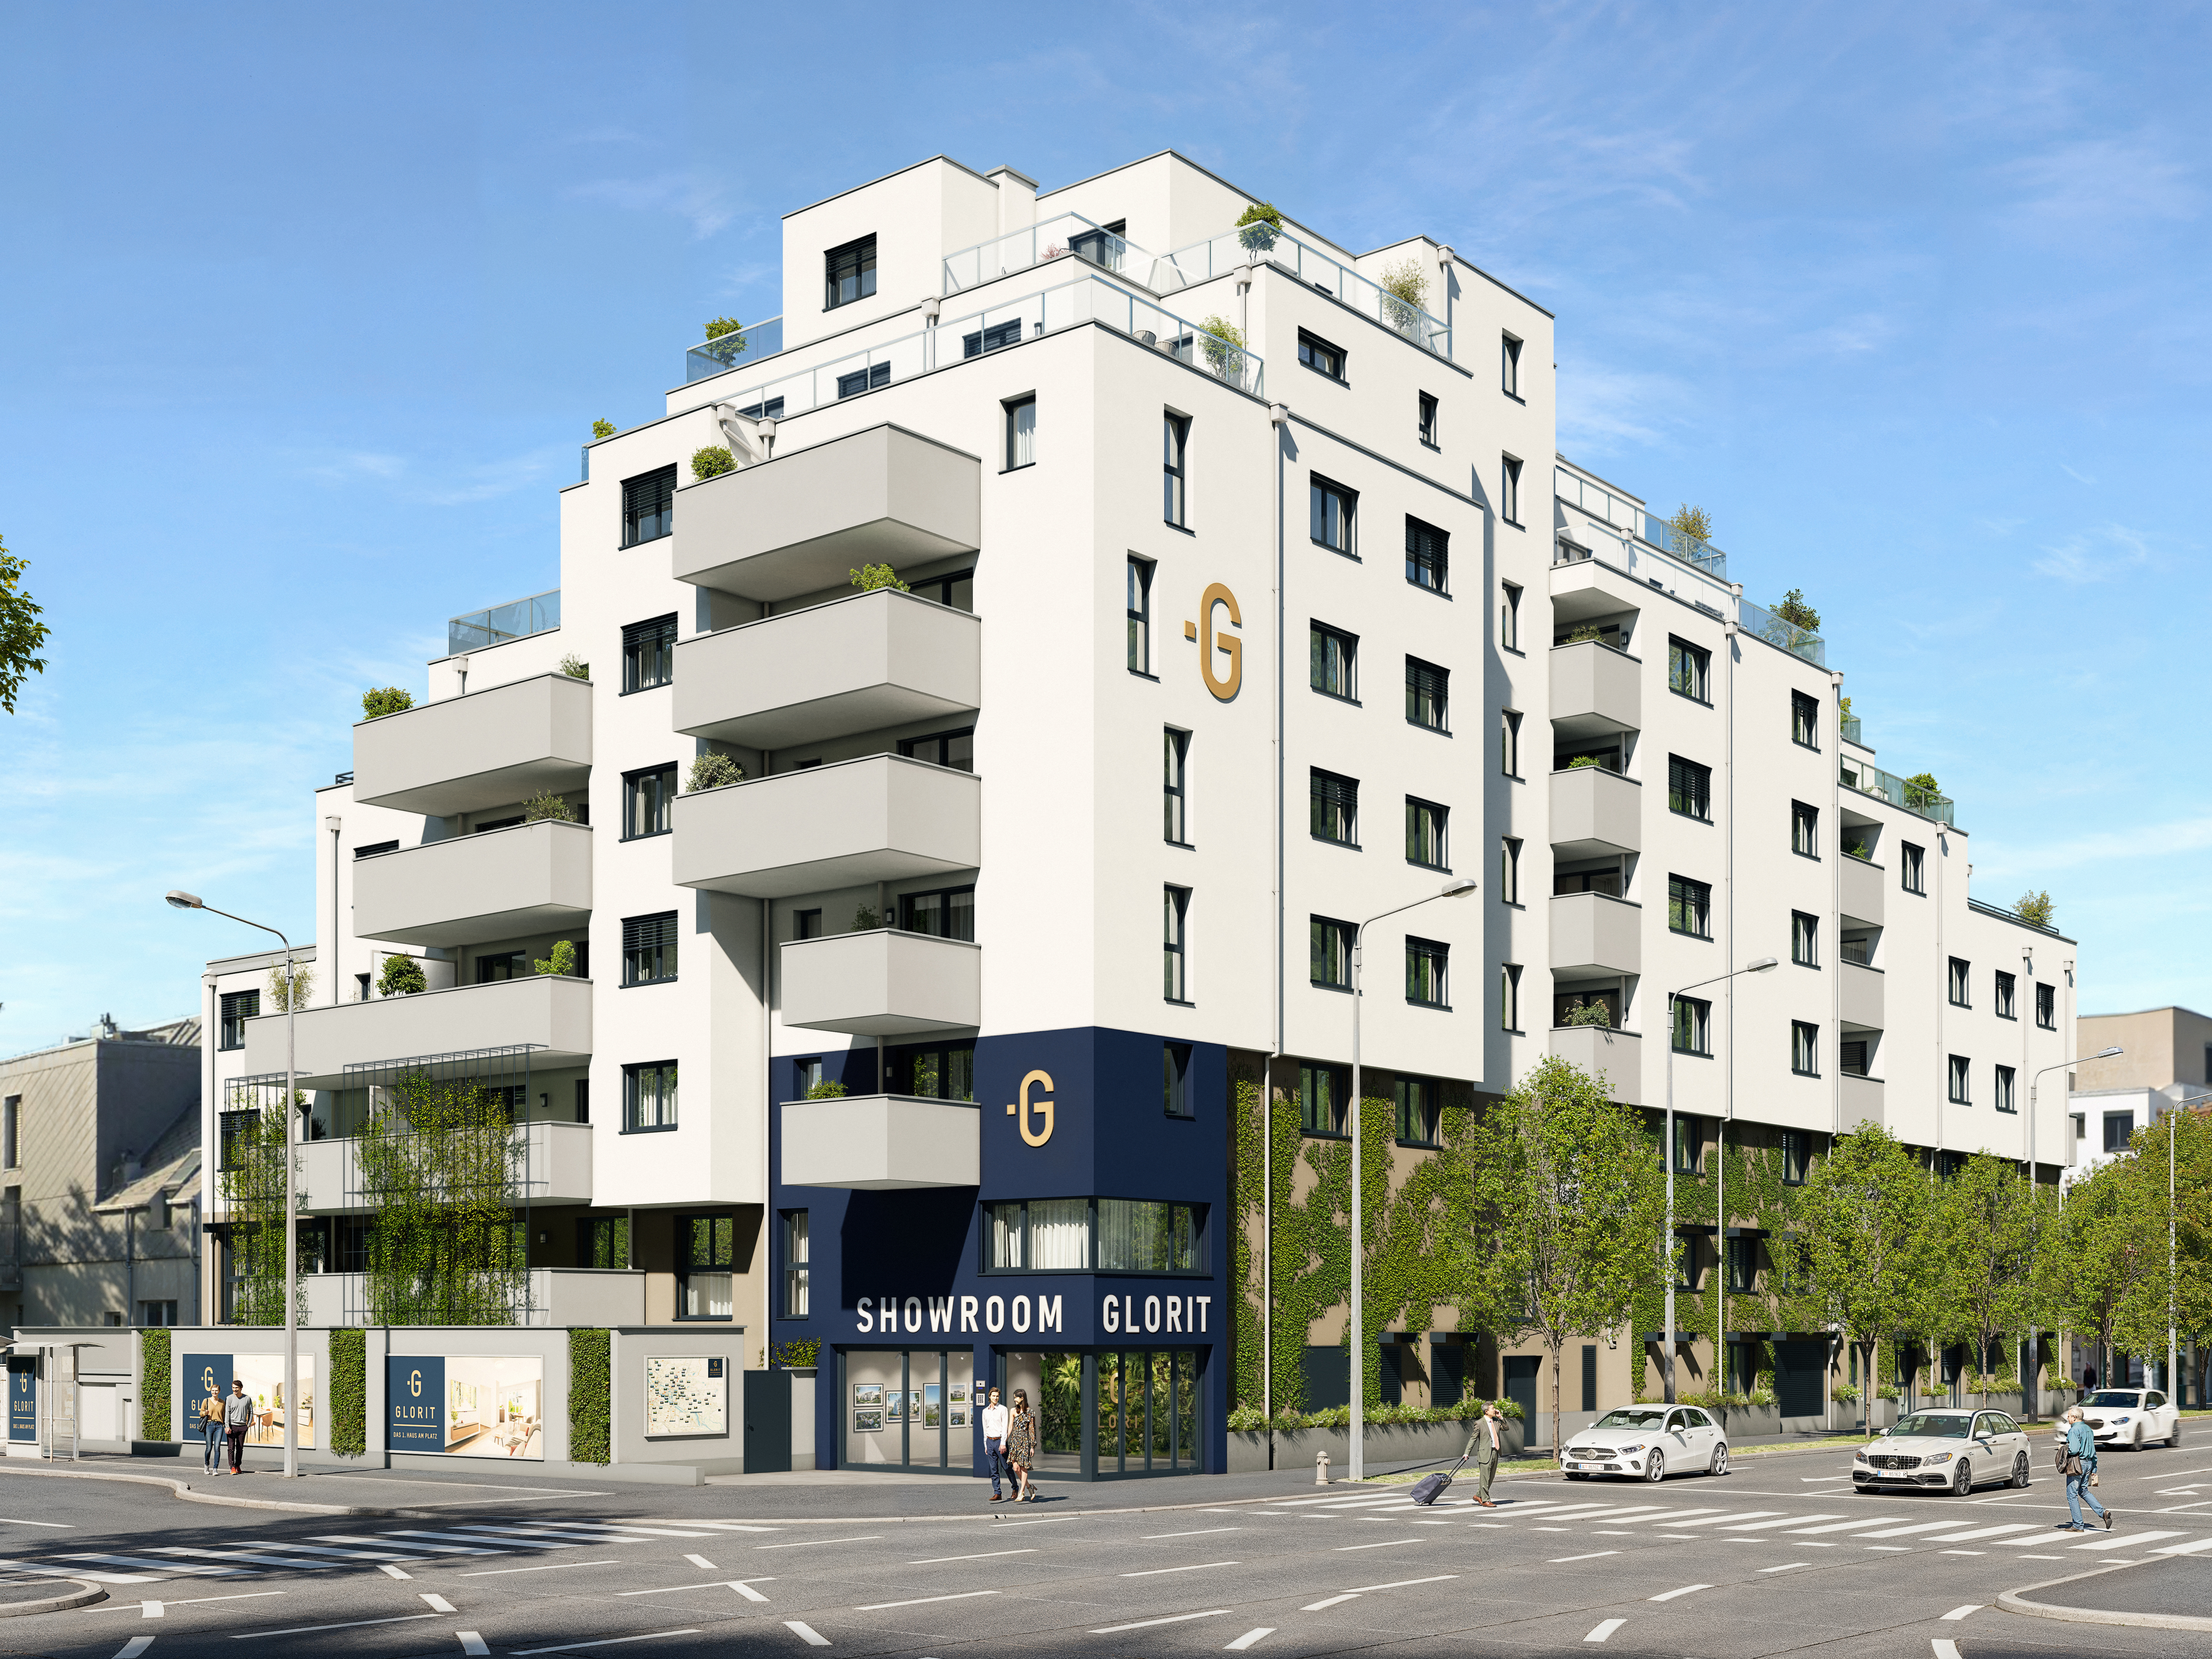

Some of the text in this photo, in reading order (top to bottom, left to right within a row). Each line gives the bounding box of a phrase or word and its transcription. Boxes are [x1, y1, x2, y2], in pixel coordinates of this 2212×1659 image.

[857, 1294, 1212, 1334] SHOWROOM GLORIT
[14, 1400, 34, 1412] GLORIT
[395, 1405, 435, 1419] GLORIT
